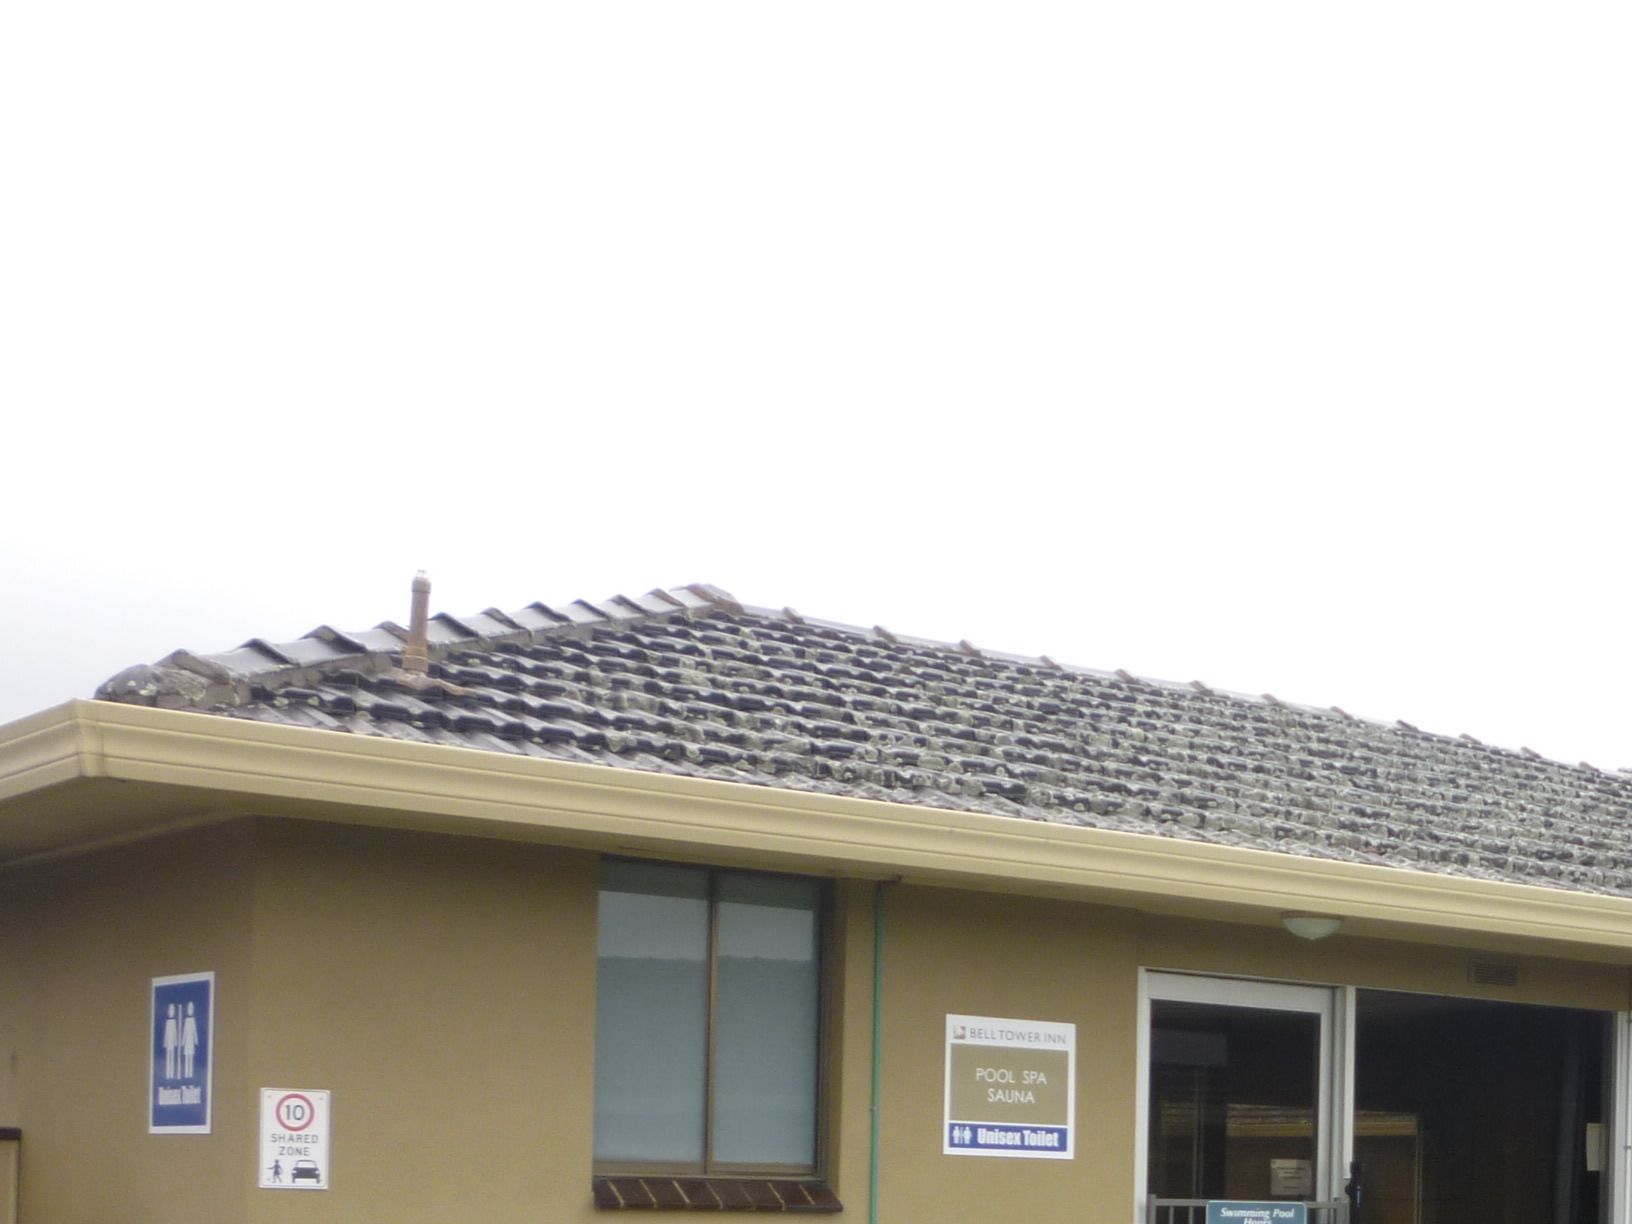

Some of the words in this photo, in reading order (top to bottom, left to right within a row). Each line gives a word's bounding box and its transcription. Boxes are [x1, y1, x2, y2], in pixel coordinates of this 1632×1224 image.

[970, 1027, 996, 1040] BELL
[998, 1029, 1041, 1042] TOWER
[1043, 1033, 1067, 1044] INN
[976, 1067, 1015, 1083] POOL
[1022, 1070, 1047, 1085] SPA
[987, 1088, 1036, 1104] SAUNA
[285, 1104, 305, 1121] 10
[271, 1133, 319, 1144] SHARED
[977, 1128, 1021, 1145] Unisex
[1022, 1130, 1059, 1147] Toilet
[279, 1146, 312, 1156] ZONE
[1220, 1207, 1270, 1219] Swimming
[1272, 1207, 1295, 1218] Pool
